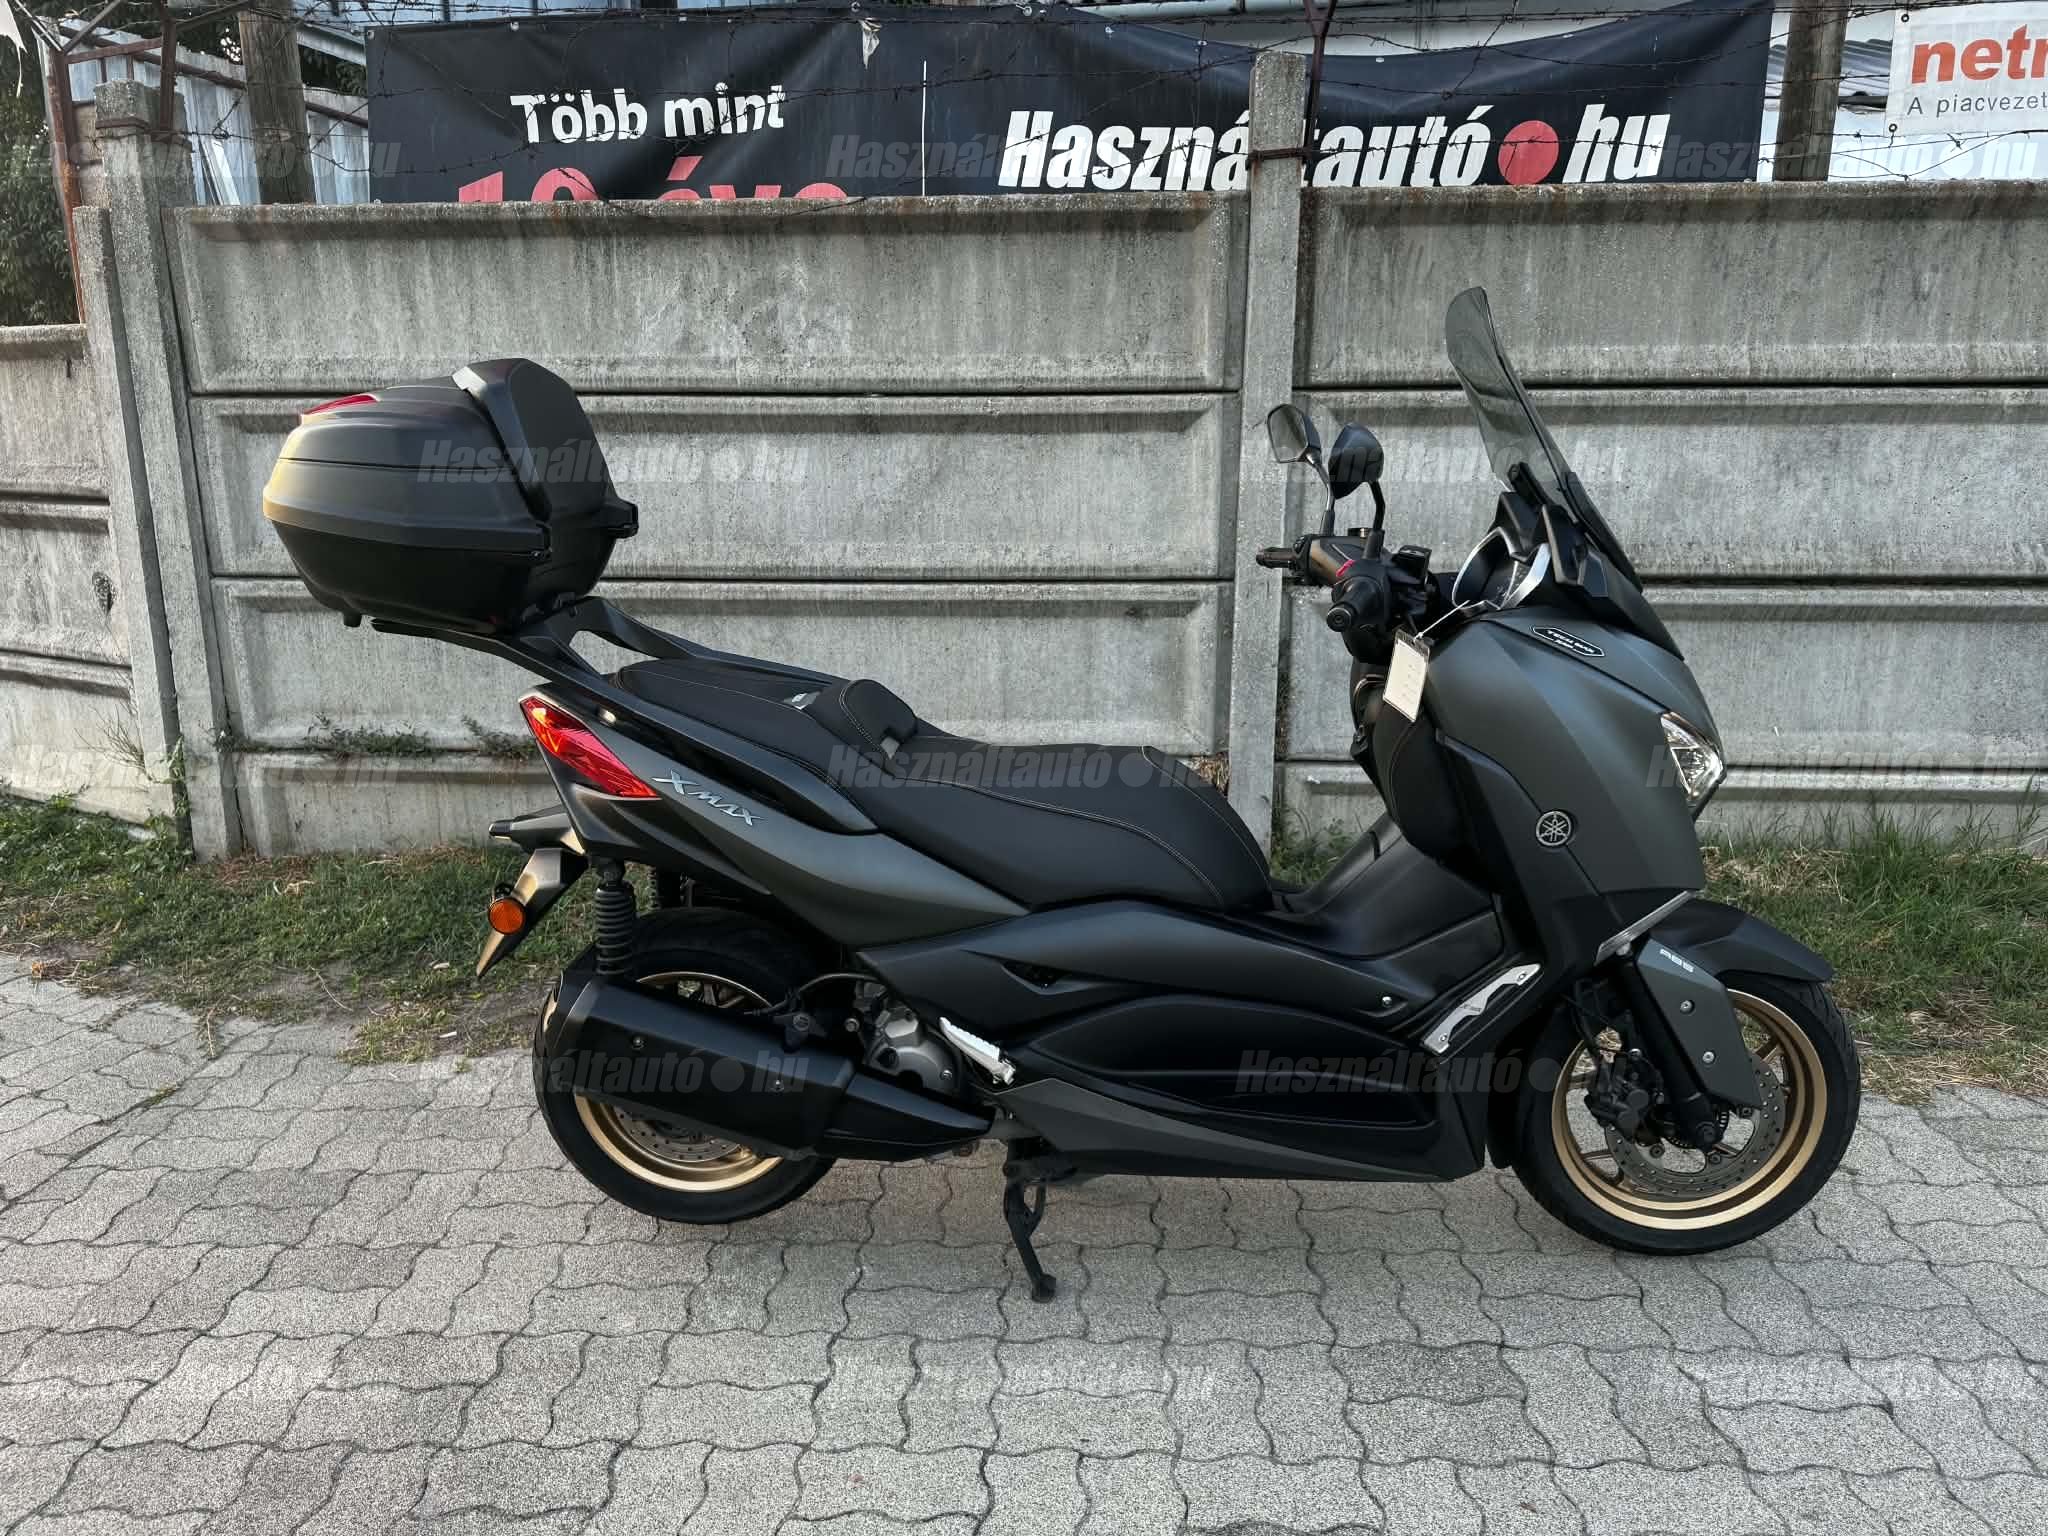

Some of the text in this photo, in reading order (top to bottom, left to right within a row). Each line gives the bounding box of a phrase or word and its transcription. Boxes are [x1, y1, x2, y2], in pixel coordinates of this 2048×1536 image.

[511, 82, 786, 144] Több mint
[1906, 97, 1923, 116] A
